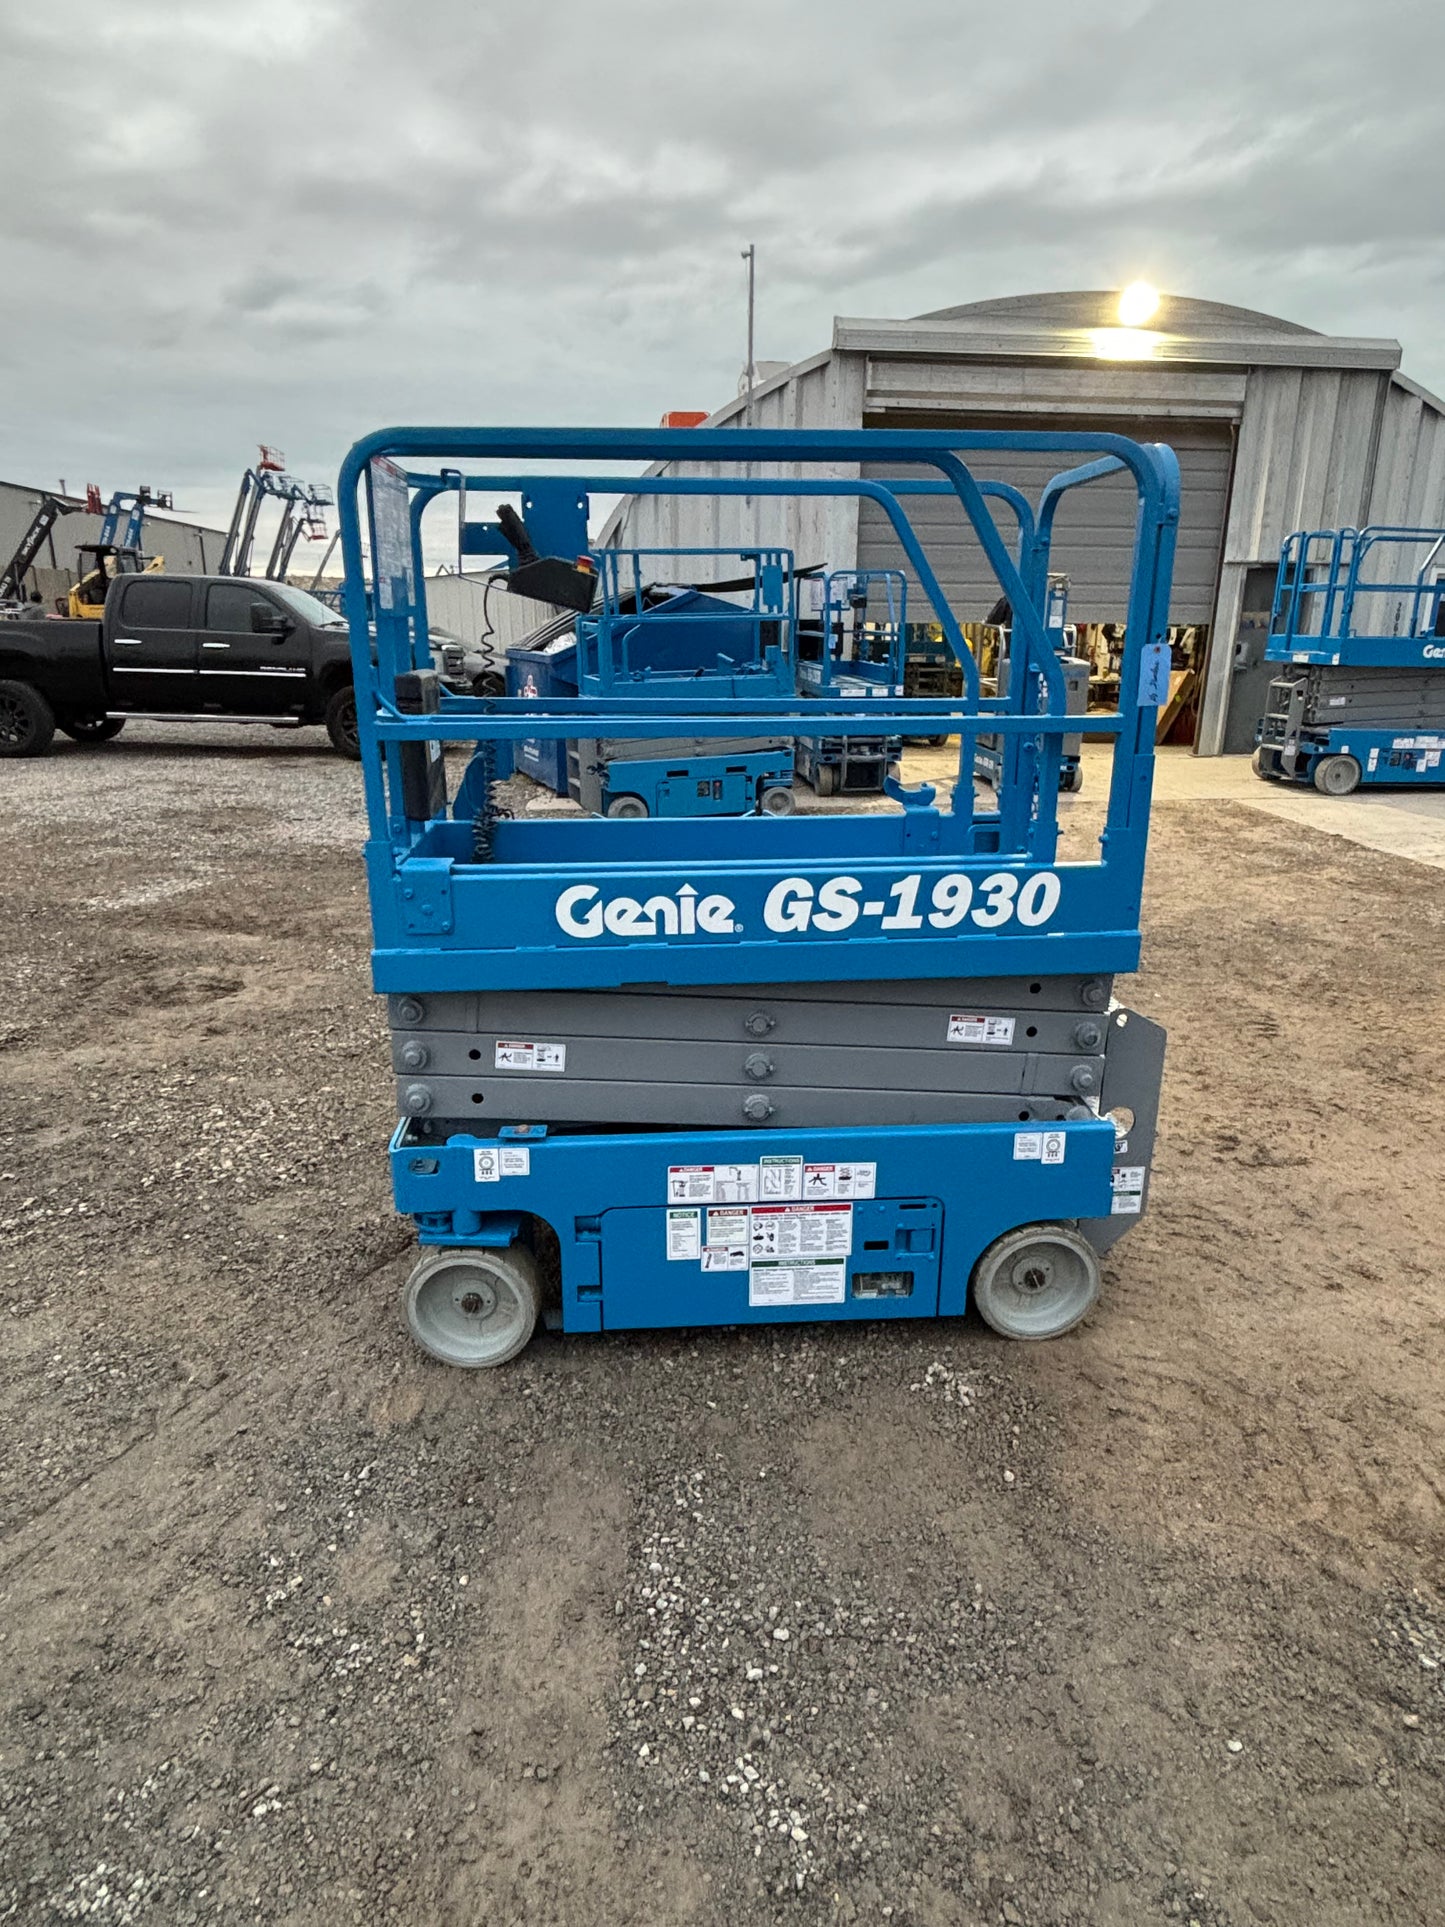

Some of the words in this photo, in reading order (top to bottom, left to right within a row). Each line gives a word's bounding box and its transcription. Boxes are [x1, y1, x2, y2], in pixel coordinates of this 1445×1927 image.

[1422, 644, 1445, 659] Ge
[555, 882, 736, 939] Genie
[763, 872, 1061, 932] GS-1930
